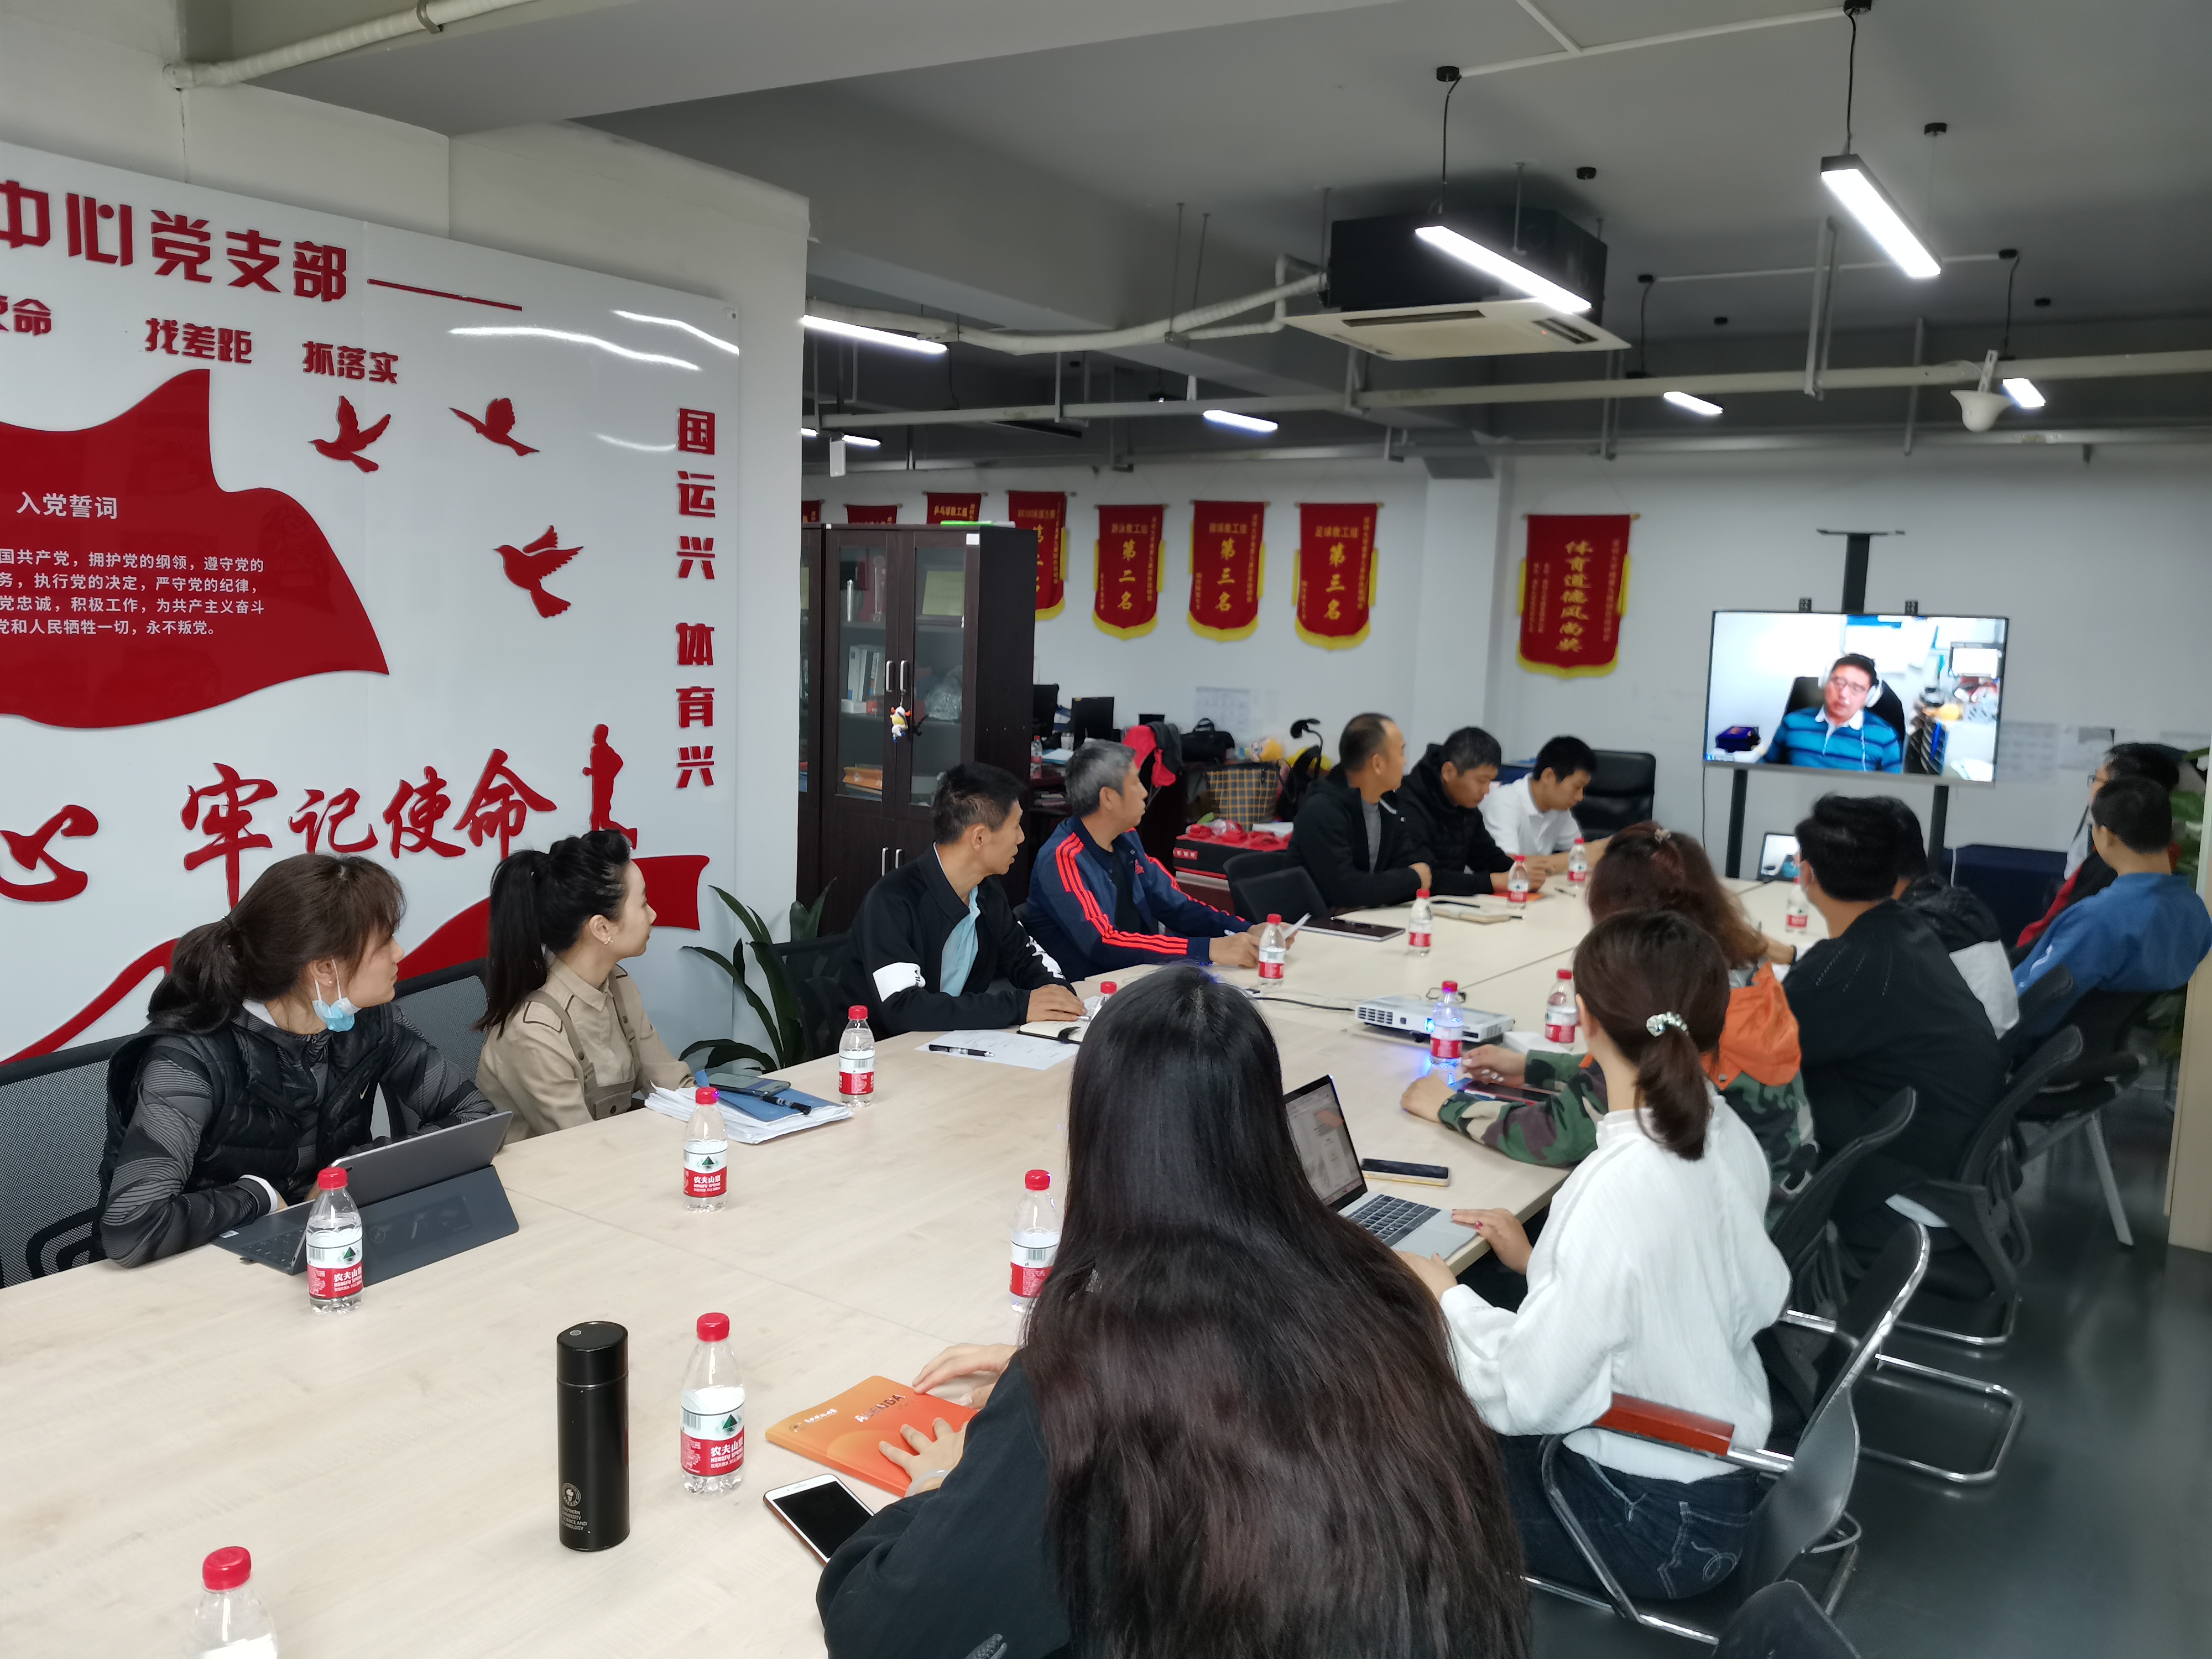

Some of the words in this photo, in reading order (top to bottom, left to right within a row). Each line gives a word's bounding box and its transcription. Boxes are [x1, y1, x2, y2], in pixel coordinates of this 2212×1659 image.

[0, 180, 347, 302] 中心党支部
[0, 295, 51, 336] 命
[145, 317, 252, 364] 找差距
[302, 341, 399, 385] 抓落实
[16, 491, 118, 519] 入党誓词
[676, 408, 716, 580] 国运兴
[1117, 539, 1136, 611] 第二名
[1215, 537, 1235, 612] 第三名
[1323, 542, 1346, 621] 第三名
[675, 622, 715, 789] 体育兴
[180, 748, 557, 910] 牢记使命
[693, 1173, 721, 1184] 农夫山泉
[854, 1394, 906, 1423] AGENDA
